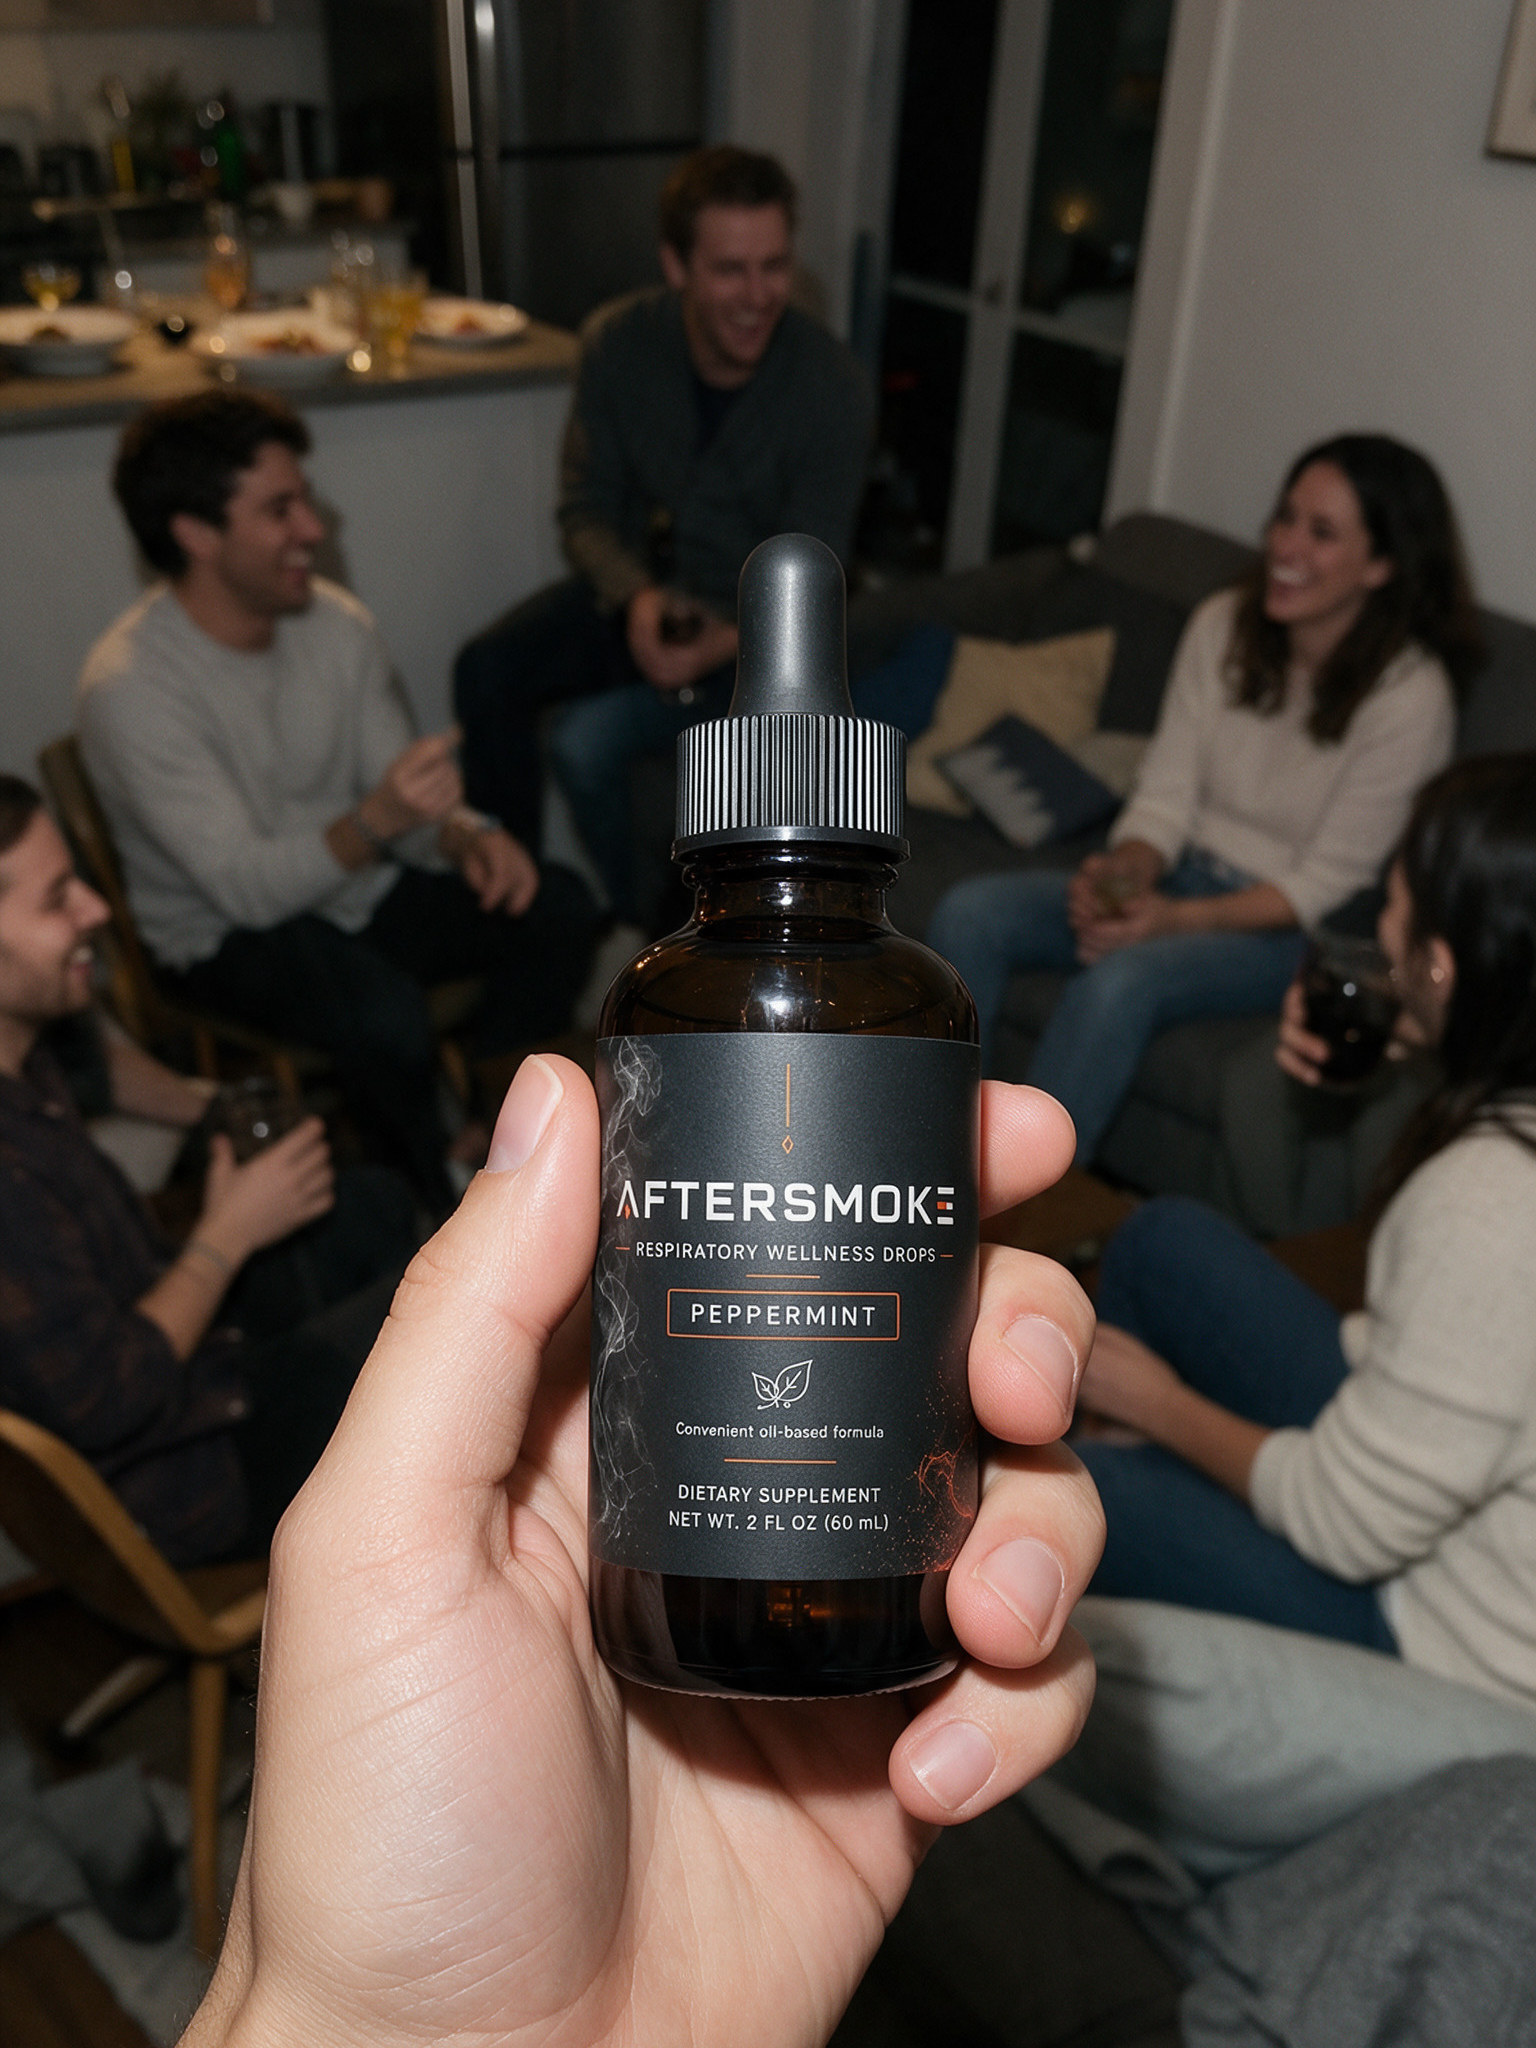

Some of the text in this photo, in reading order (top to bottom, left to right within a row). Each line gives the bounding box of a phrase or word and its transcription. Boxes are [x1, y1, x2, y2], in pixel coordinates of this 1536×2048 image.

[615, 1179, 955, 1226] AFTERSMOKE
[635, 1240, 937, 1264] RESPIRATORY WELLNESS DROPS
[690, 1302, 877, 1328] PEPPERMINT
[675, 1421, 755, 1439] Convenient
[832, 1424, 884, 1439] formula
[678, 1484, 881, 1504] DIETARY SUPPLEMENT
[669, 1510, 889, 1533] NET WT. 2 FL OZ (60 mL)
